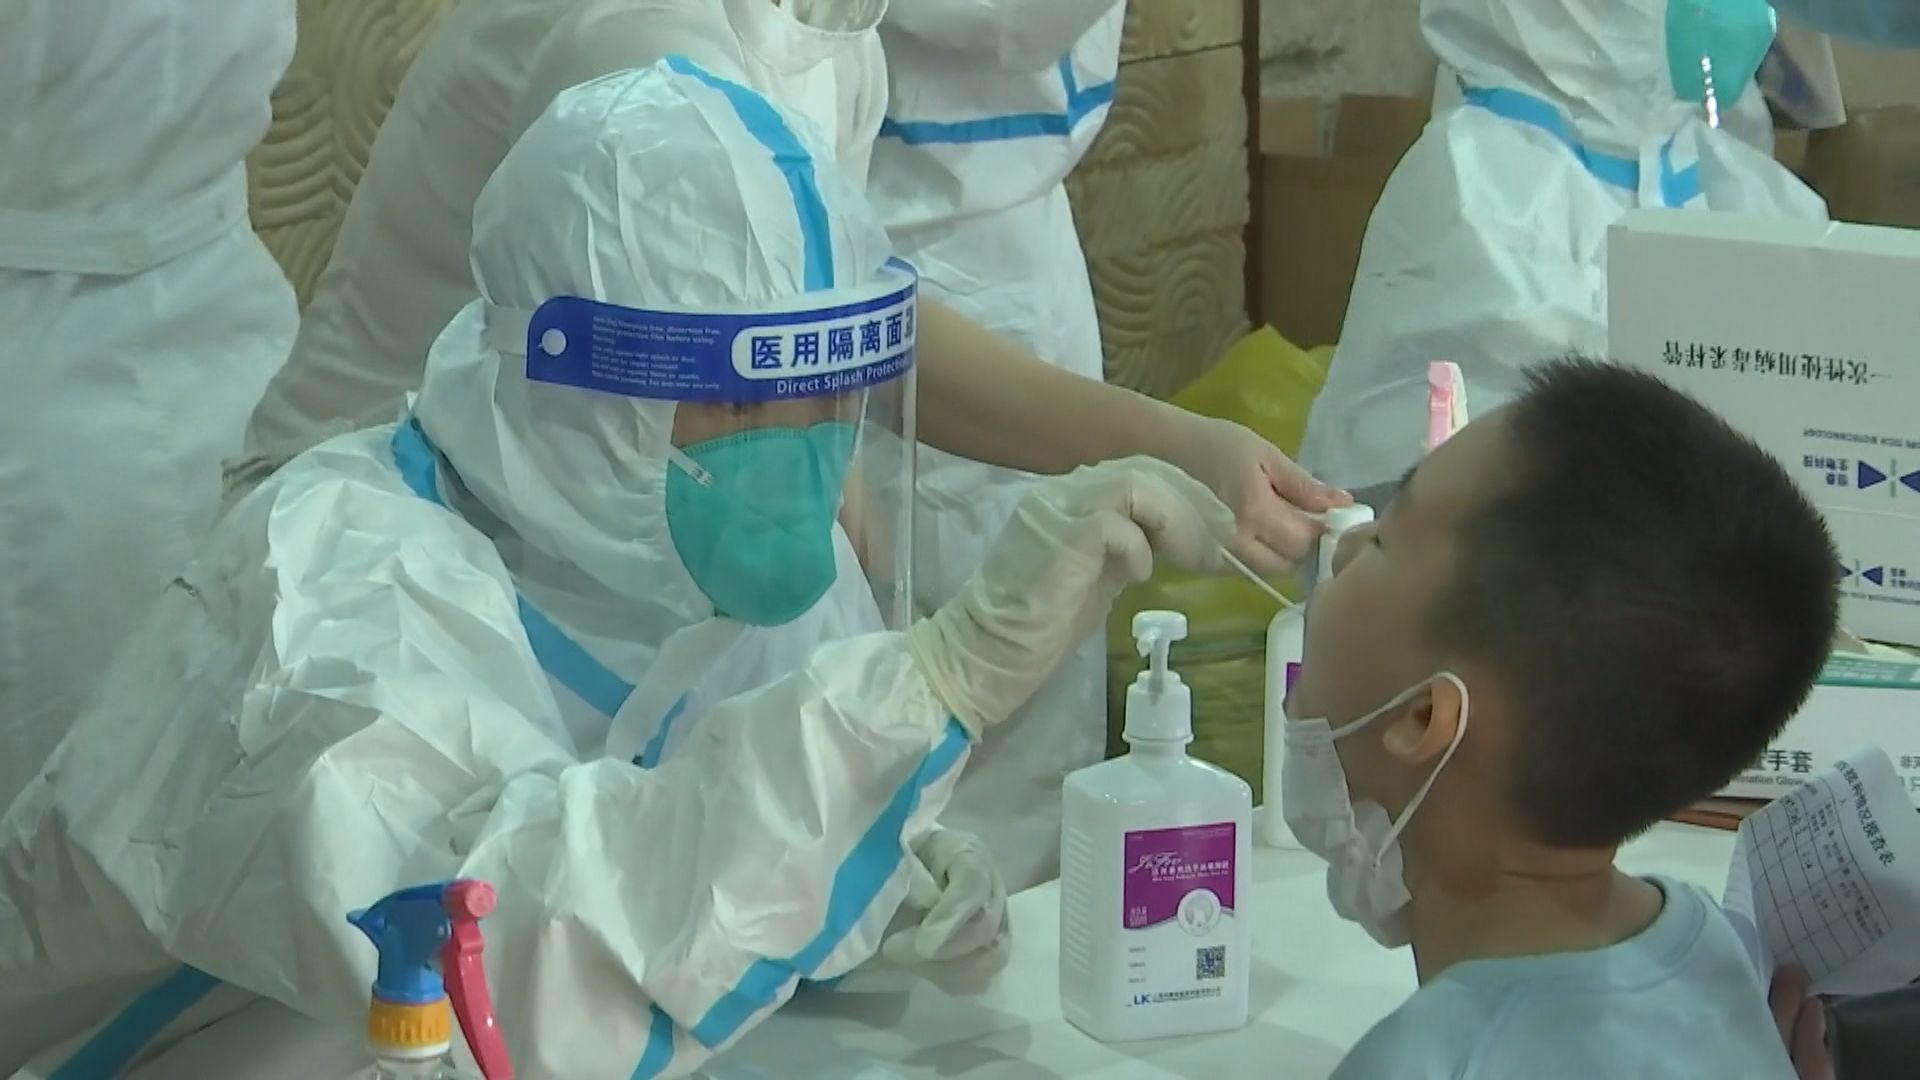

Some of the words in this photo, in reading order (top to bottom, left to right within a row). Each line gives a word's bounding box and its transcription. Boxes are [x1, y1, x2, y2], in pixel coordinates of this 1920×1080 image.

[1662, 340, 1892, 385] 一次性使用病毒采样管
[777, 379, 820, 394] Direct
[824, 370, 863, 390] Splash
[1757, 750, 1812, 773] 手套
[1134, 994, 1150, 1006] LK
